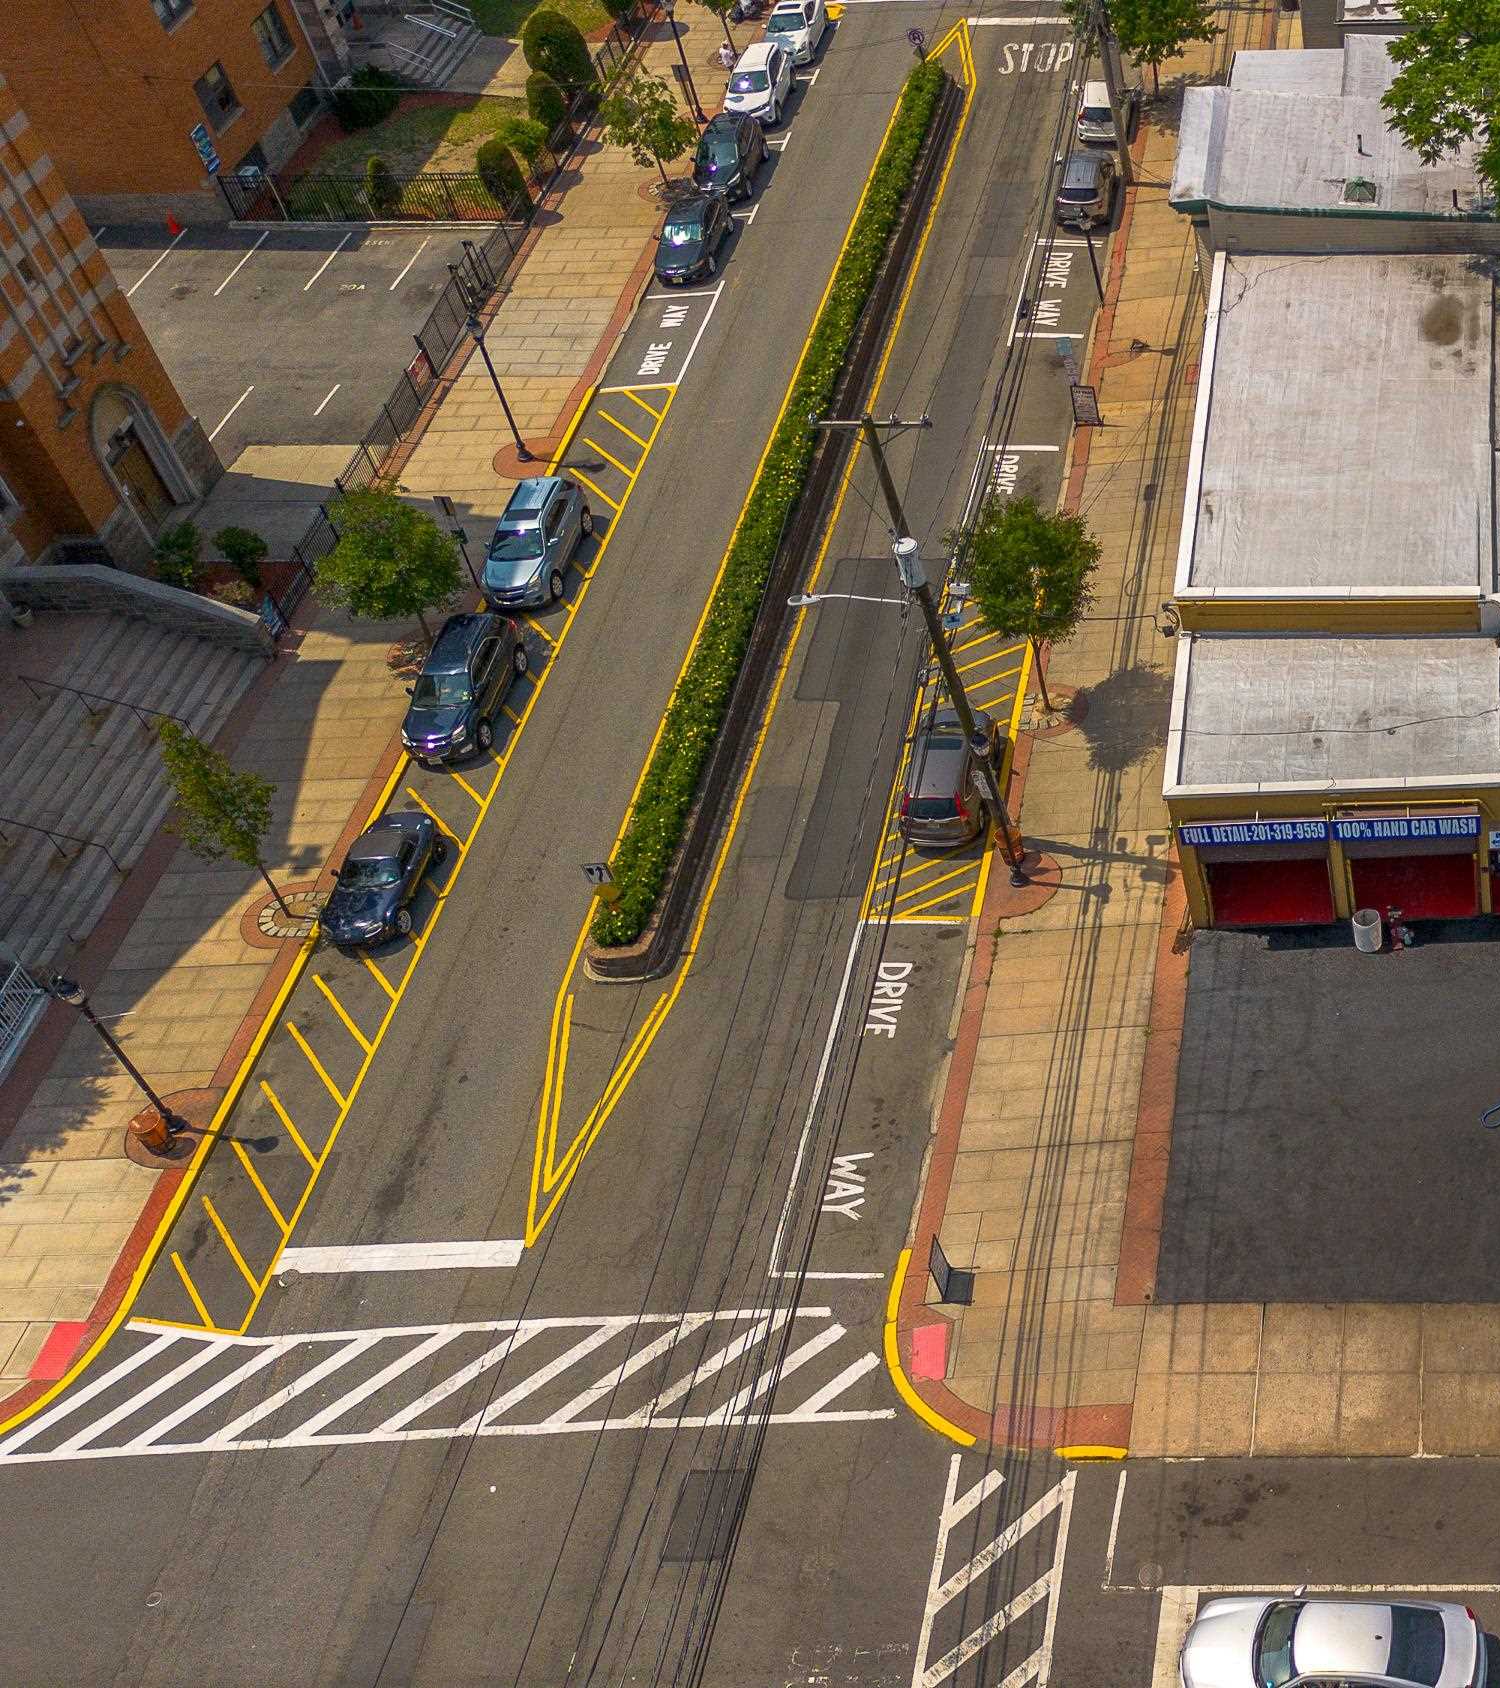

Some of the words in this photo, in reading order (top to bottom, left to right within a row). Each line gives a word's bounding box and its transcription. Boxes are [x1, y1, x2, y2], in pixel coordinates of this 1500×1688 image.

[998, 42, 1074, 75] STOP
[1040, 252, 1073, 288] DRIVE
[1032, 299, 1062, 326] WAY
[637, 341, 672, 375] DRIVE
[660, 305, 689, 328] WAY
[986, 454, 1020, 494] DRIVE
[1183, 827, 1211, 844] FULL
[1336, 822, 1371, 839] 100%
[1374, 820, 1407, 837] HAND
[1411, 819, 1438, 836] CAR
[1439, 818, 1478, 835] WASH
[861, 961, 913, 1039] DRIVE
[821, 1152, 874, 1221] WAY
